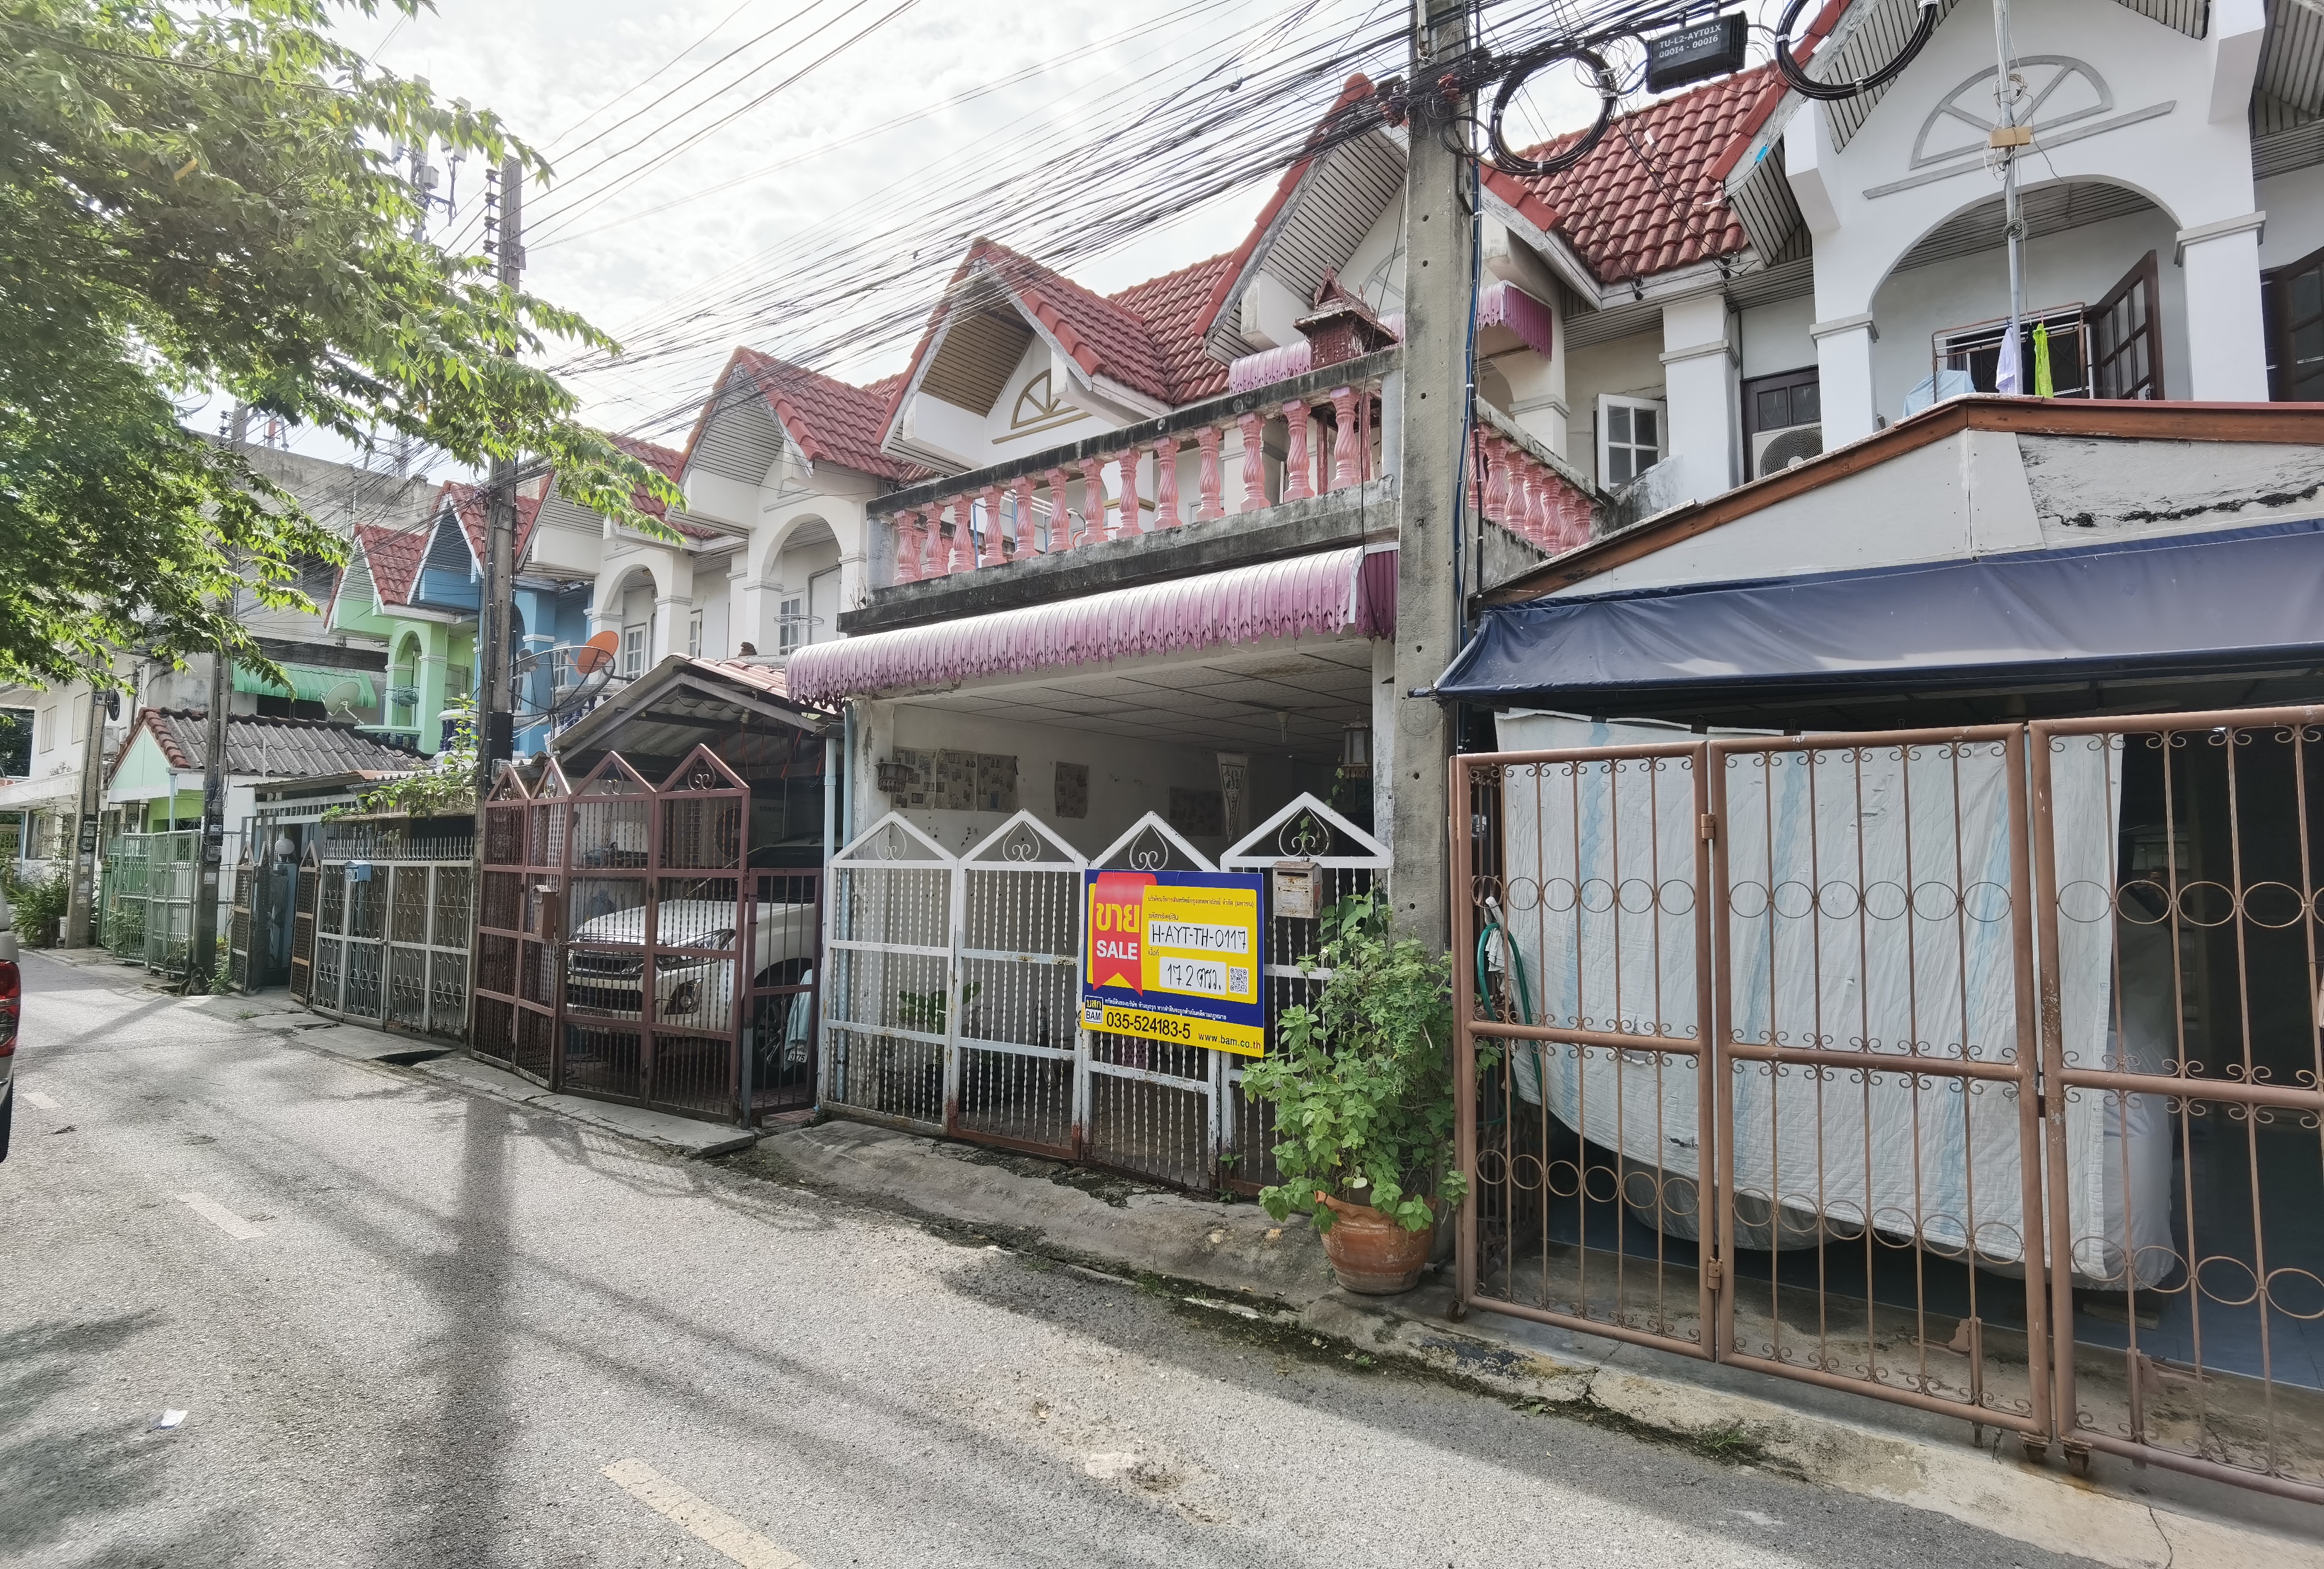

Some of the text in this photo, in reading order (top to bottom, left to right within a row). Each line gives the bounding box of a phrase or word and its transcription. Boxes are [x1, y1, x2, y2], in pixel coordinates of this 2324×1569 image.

[1659, 24, 1722, 48] TU-L2-AYT01X
[1096, 903, 1140, 933] ขาย
[1152, 924, 1246, 950] H-AYT-TH-0117
[1096, 939, 1138, 960] SALE
[1086, 999, 1101, 1009] บสก
[1086, 1010, 1101, 1021] BAM
[1106, 1011, 1261, 1050] 035-524183-5 www.bam.co.th
